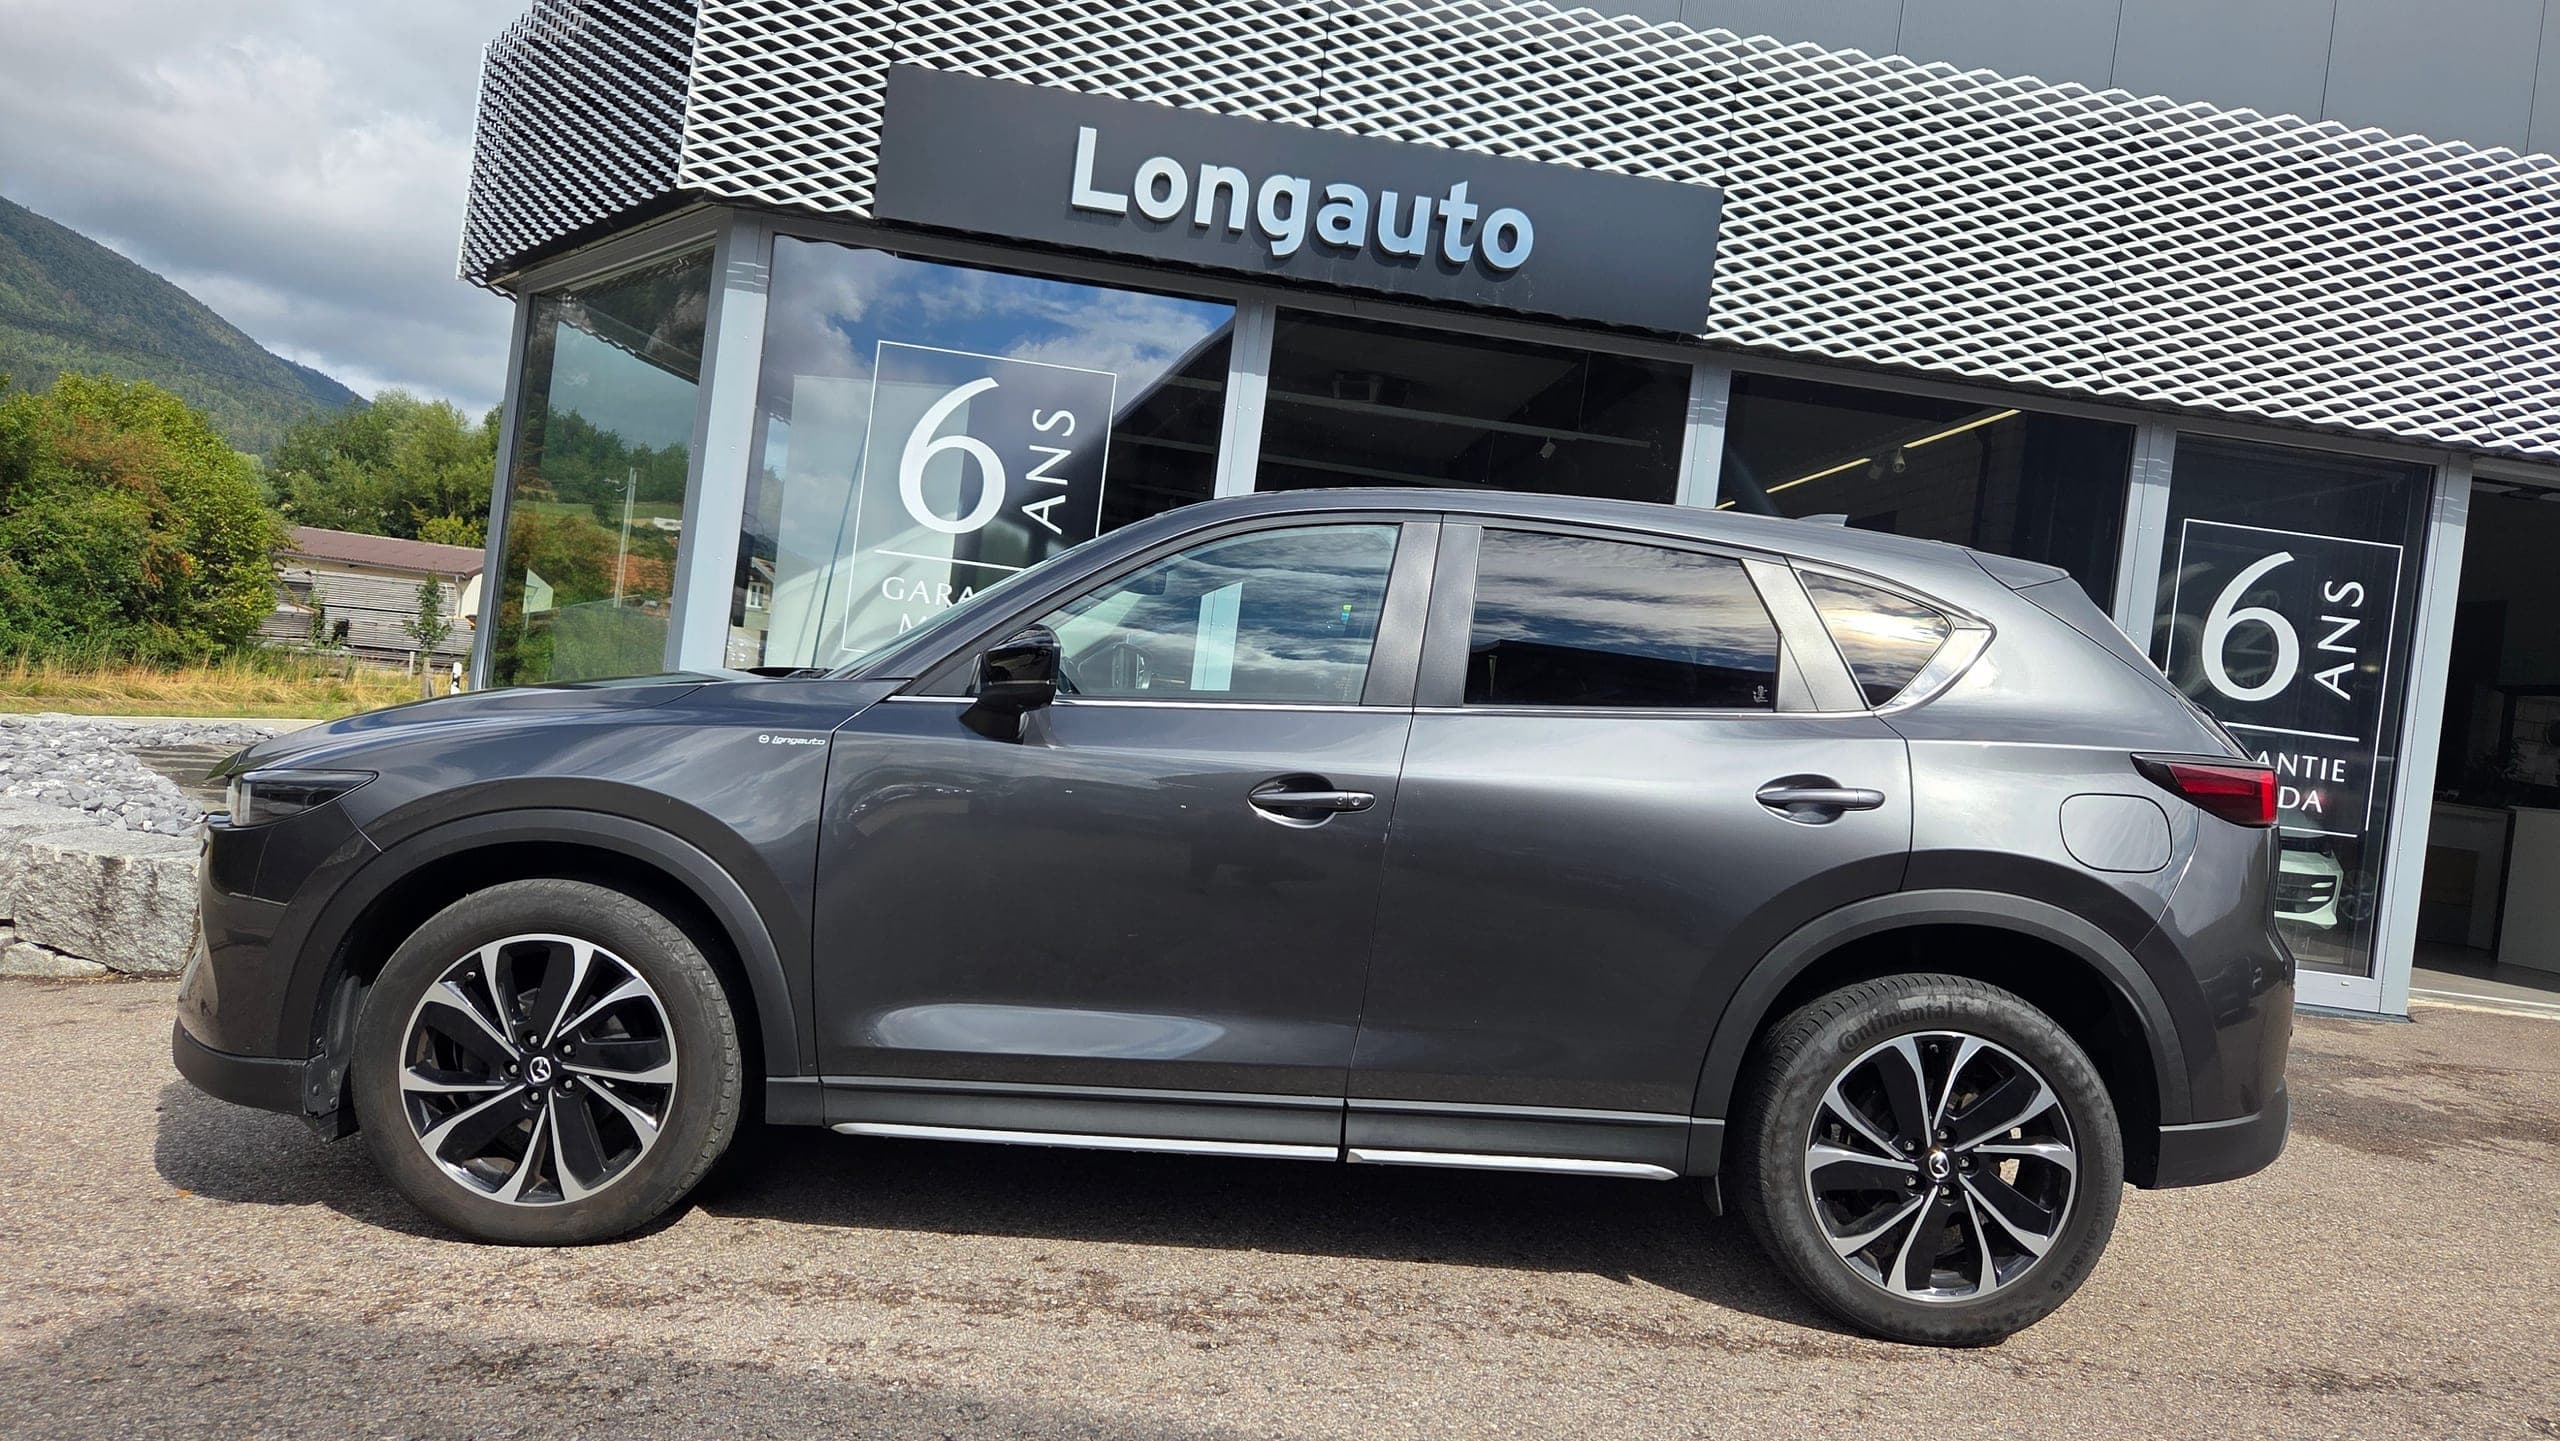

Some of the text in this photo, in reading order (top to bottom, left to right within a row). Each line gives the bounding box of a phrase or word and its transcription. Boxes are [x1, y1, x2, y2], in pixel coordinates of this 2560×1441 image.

[1071, 126, 1534, 271] Longauto
[899, 377, 1076, 535] 6 ANS
[882, 576, 975, 607] GARA
[2202, 551, 2365, 701] 6 ANS
[2257, 750, 2347, 783] ANTIE
[2277, 785, 2323, 814] DA
